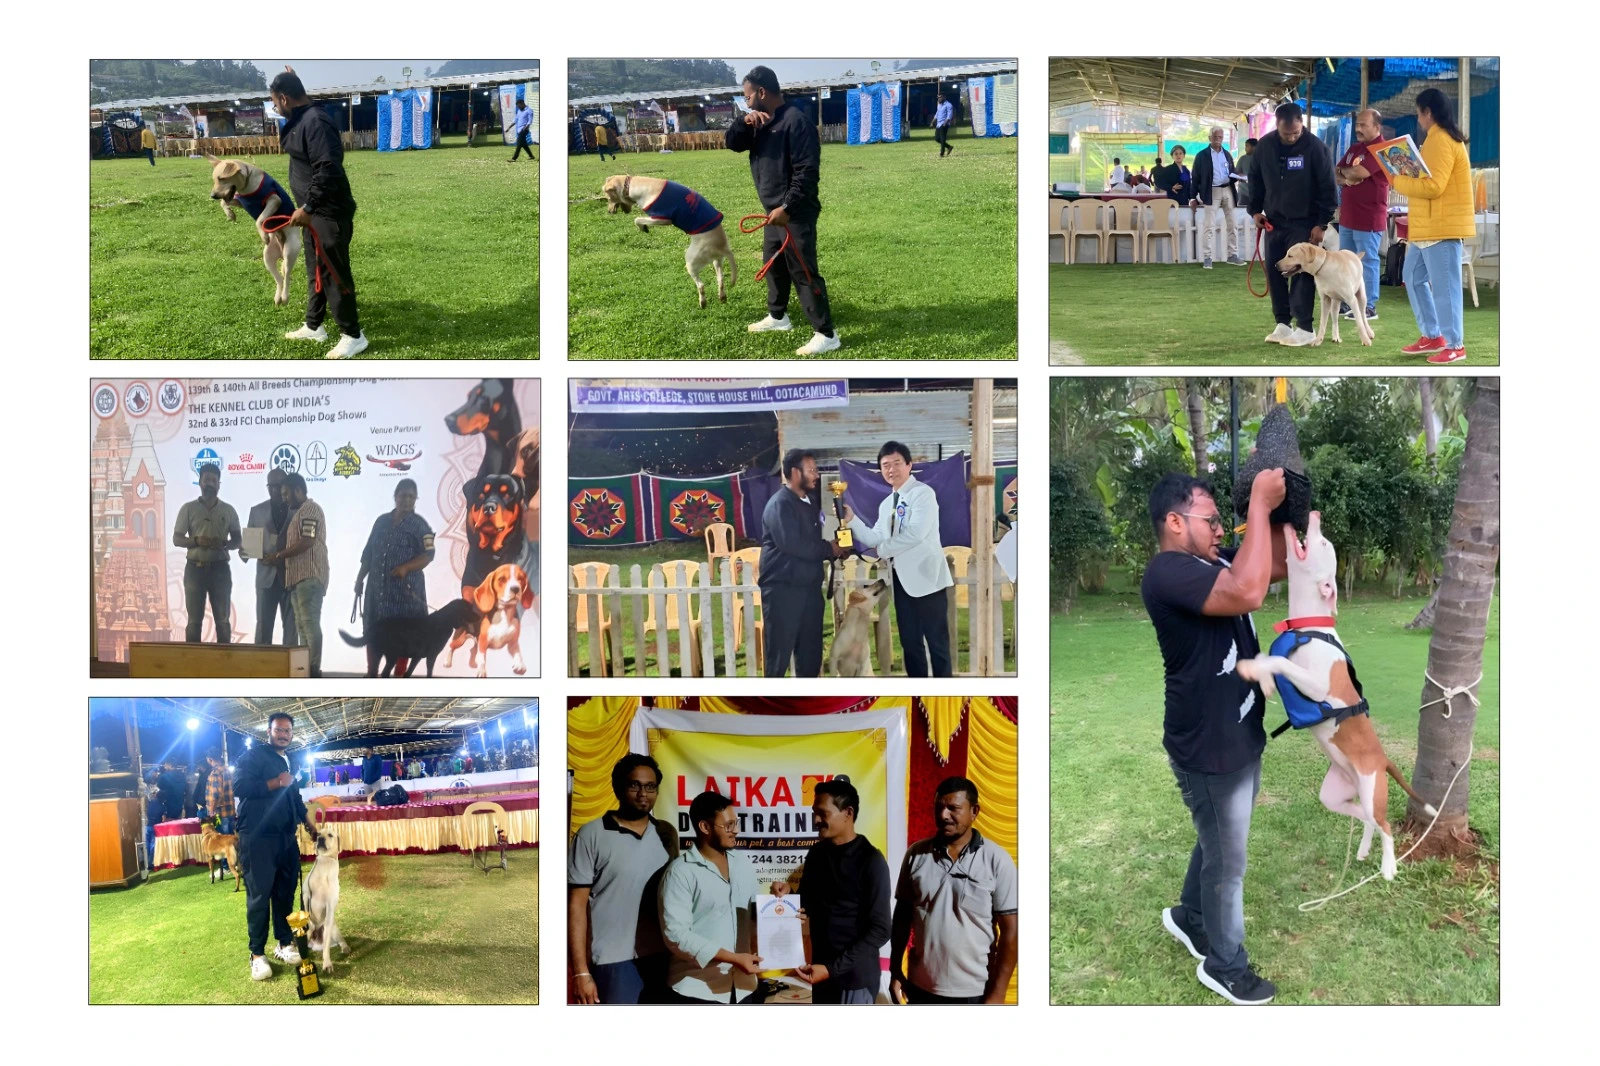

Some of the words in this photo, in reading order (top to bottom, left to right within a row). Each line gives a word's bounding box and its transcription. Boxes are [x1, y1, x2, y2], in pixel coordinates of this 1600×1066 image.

[188, 384, 211, 395] 139th
[214, 383, 220, 393] &
[222, 382, 246, 392] 140th
[248, 381, 260, 391] All
[262, 379, 291, 390] Breeds
[588, 390, 615, 402] GOVT.
[618, 390, 640, 402] ARTS
[688, 392, 716, 402] STONE
[718, 392, 748, 402] HOUSE
[750, 390, 773, 401] HILL,
[775, 384, 838, 399] OOTACAMUND
[188, 403, 206, 414] THE
[208, 402, 246, 413] KENNEL
[248, 400, 273, 410] CLUB
[276, 398, 290, 408] OF
[188, 418, 208, 428] 32nd
[210, 418, 218, 428] &
[220, 416, 238, 426] 33rd
[240, 416, 252, 426] FCI
[254, 412, 316, 426] Championship
[318, 412, 336, 422] Dog
[338, 410, 366, 420] Shows
[370, 426, 392, 434] Venue
[394, 426, 422, 434] Partner
[202, 436, 232, 444] Sponsors
[376, 444, 415, 456] WINGS
[748, 855, 772, 864] 244
[776, 855, 806, 864] 3821
